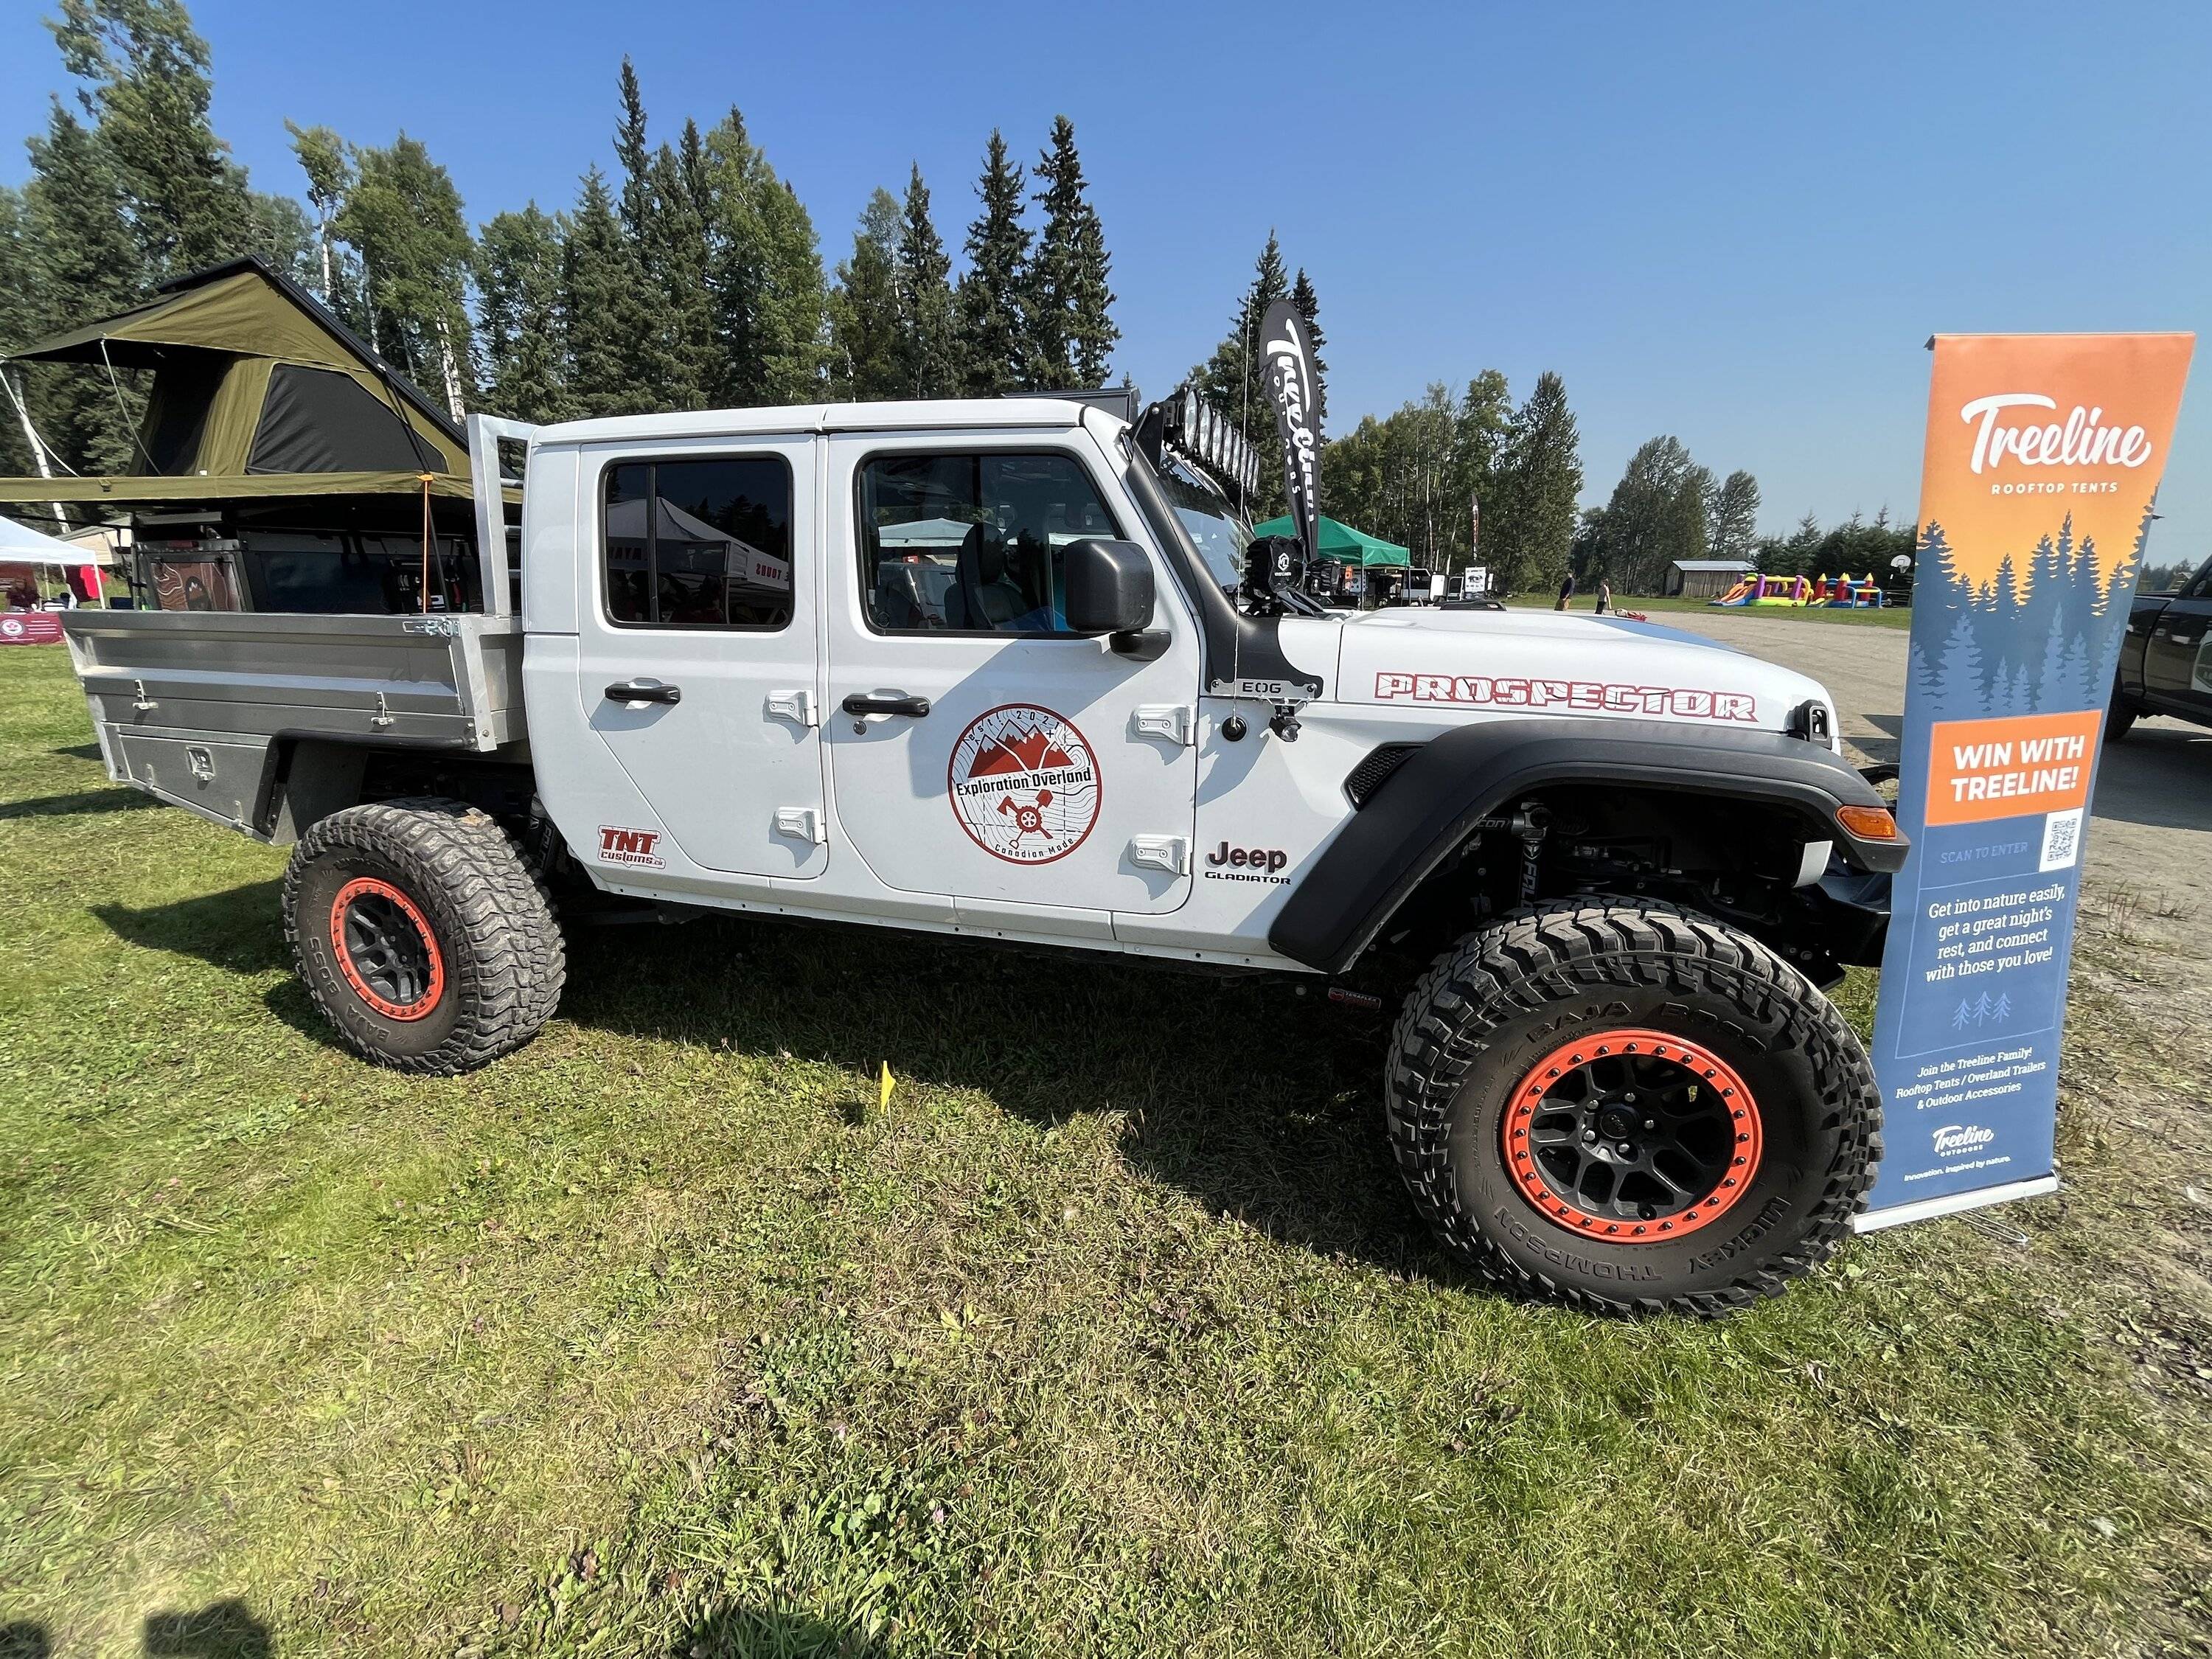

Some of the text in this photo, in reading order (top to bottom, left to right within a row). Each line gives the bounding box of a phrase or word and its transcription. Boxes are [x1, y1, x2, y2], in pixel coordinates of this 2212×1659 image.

[1960, 393, 2152, 474] Treeline
[1992, 481, 2118, 495] ROOFTOP TENTS
[1242, 681, 1281, 694] EOG
[1374, 672, 1759, 723] PROSPECTOR
[1016, 710, 1060, 730] 2021
[1953, 735, 2085, 771] WIN WITH
[956, 768, 1091, 797] Exploration Overland
[1950, 766, 2079, 802] TREELINE!
[601, 829, 658, 855] TNT
[995, 838, 1074, 858] Canadian Made
[1208, 841, 1287, 873] Jeep
[1941, 842, 2028, 863] SCAN TO ENTER
[1204, 872, 1291, 885] GLADIATOR
[1928, 883, 2065, 919] Get into nature easily,
[1938, 906, 2053, 942] get a great night's
[1937, 928, 2048, 959] rest, and connect
[1926, 946, 2053, 982] with those you love!
[1917, 1046, 2033, 1078] Join the Treeline Family!
[1896, 1061, 2047, 1099] Rooftop Tents / Overland Trailers
[1917, 1082, 2023, 1110] & Outdoor Accessories
[1932, 1125, 1994, 1153] Treeline
[1976, 1159, 1985, 1169] by
[1494, 1196, 1792, 1282] MICKEY THOMPSON
